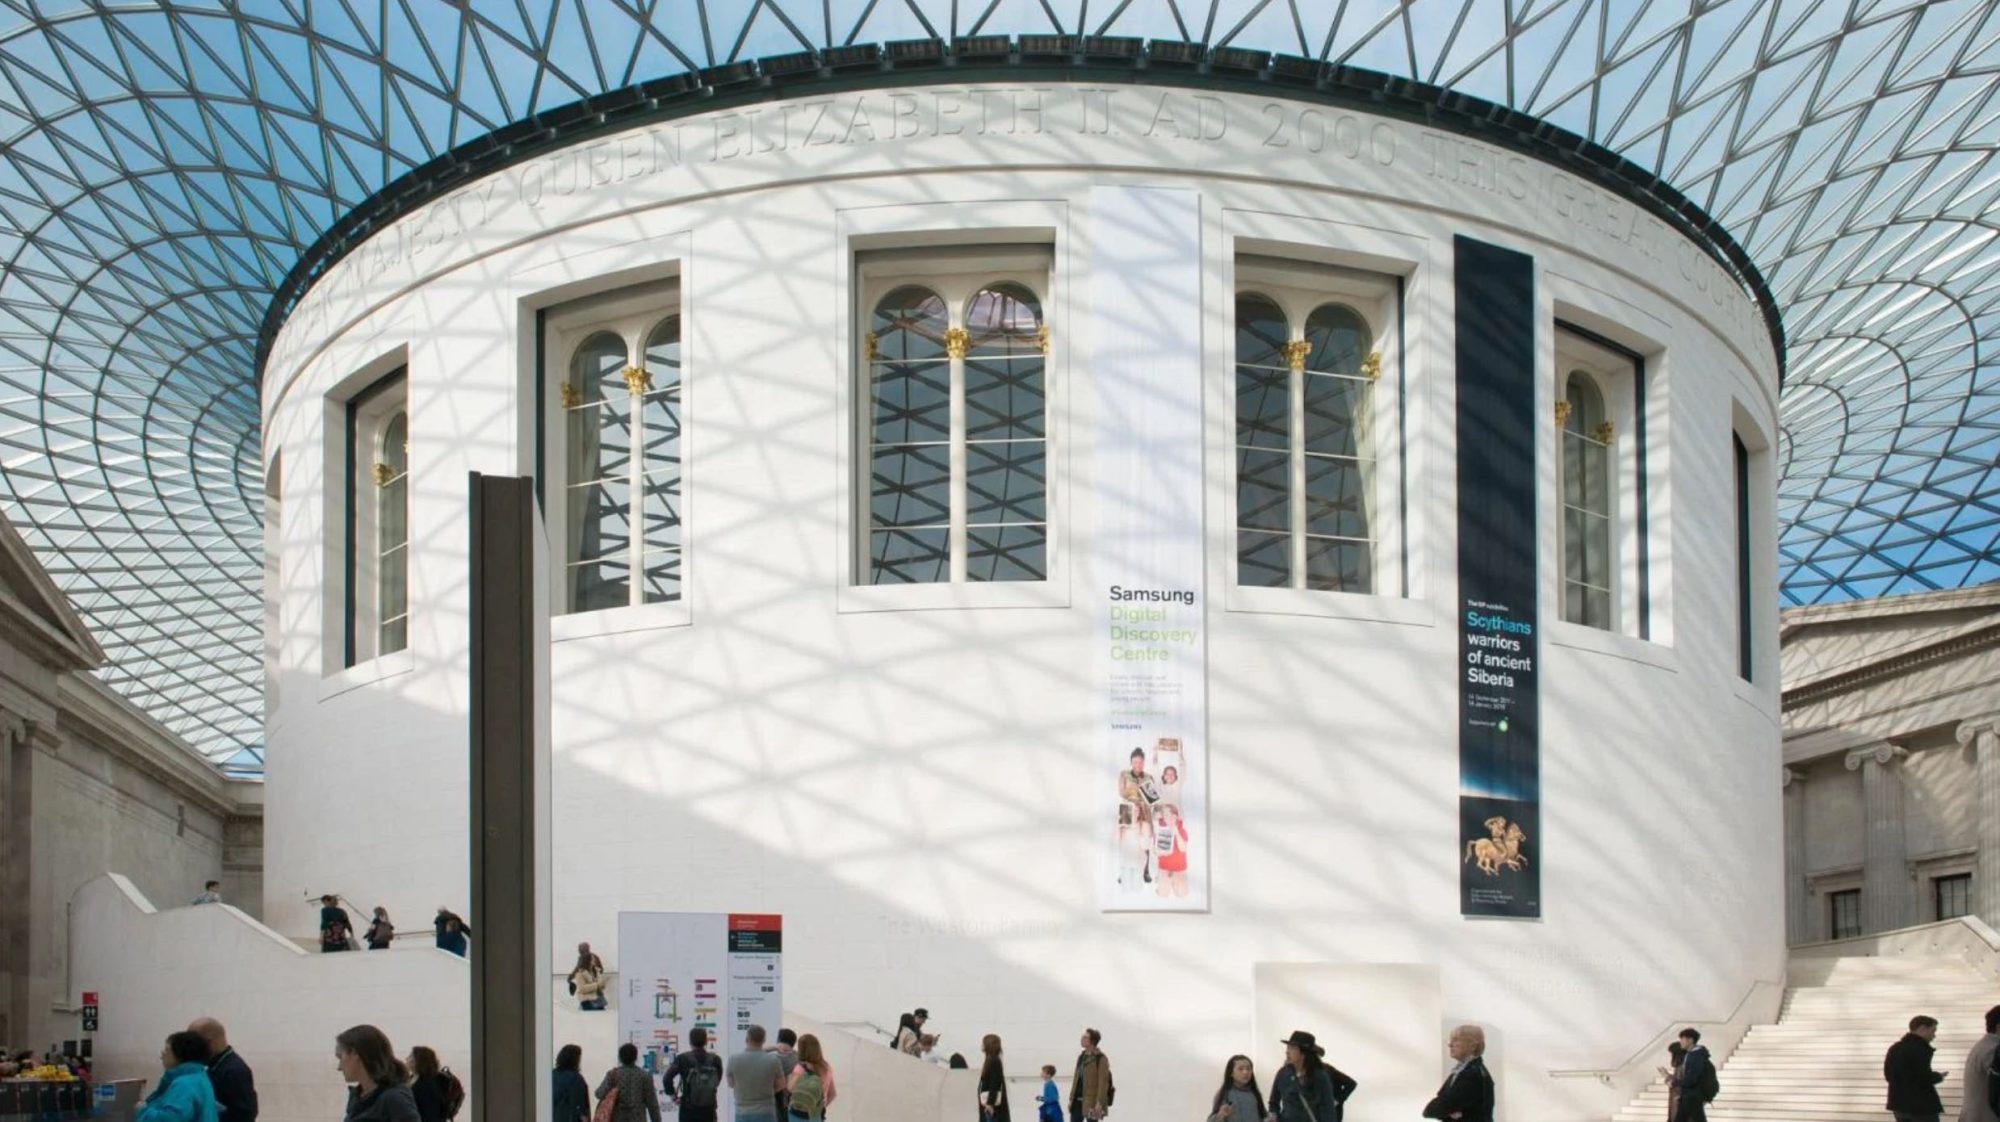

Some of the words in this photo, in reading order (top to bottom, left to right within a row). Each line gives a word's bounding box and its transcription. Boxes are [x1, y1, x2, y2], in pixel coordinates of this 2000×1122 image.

[519, 123, 687, 211] QUEEN
[709, 88, 1053, 162] ELIZABETH
[1077, 88, 1119, 135] II
[1142, 92, 1228, 141] AD
[1262, 103, 1397, 167] 2000
[1421, 132, 1529, 200] THIS
[1551, 172, 1665, 264] GREAT
[1110, 585, 1195, 605] Samsung
[1110, 606, 1167, 624] Digital
[1467, 611, 1532, 635] Scythians
[1110, 625, 1198, 645] Discovery
[1467, 633, 1521, 652] warriors
[1110, 645, 1170, 662] Centre
[1467, 650, 1483, 665] of
[1484, 655, 1532, 672] ancient
[1467, 667, 1515, 688] Siberia
